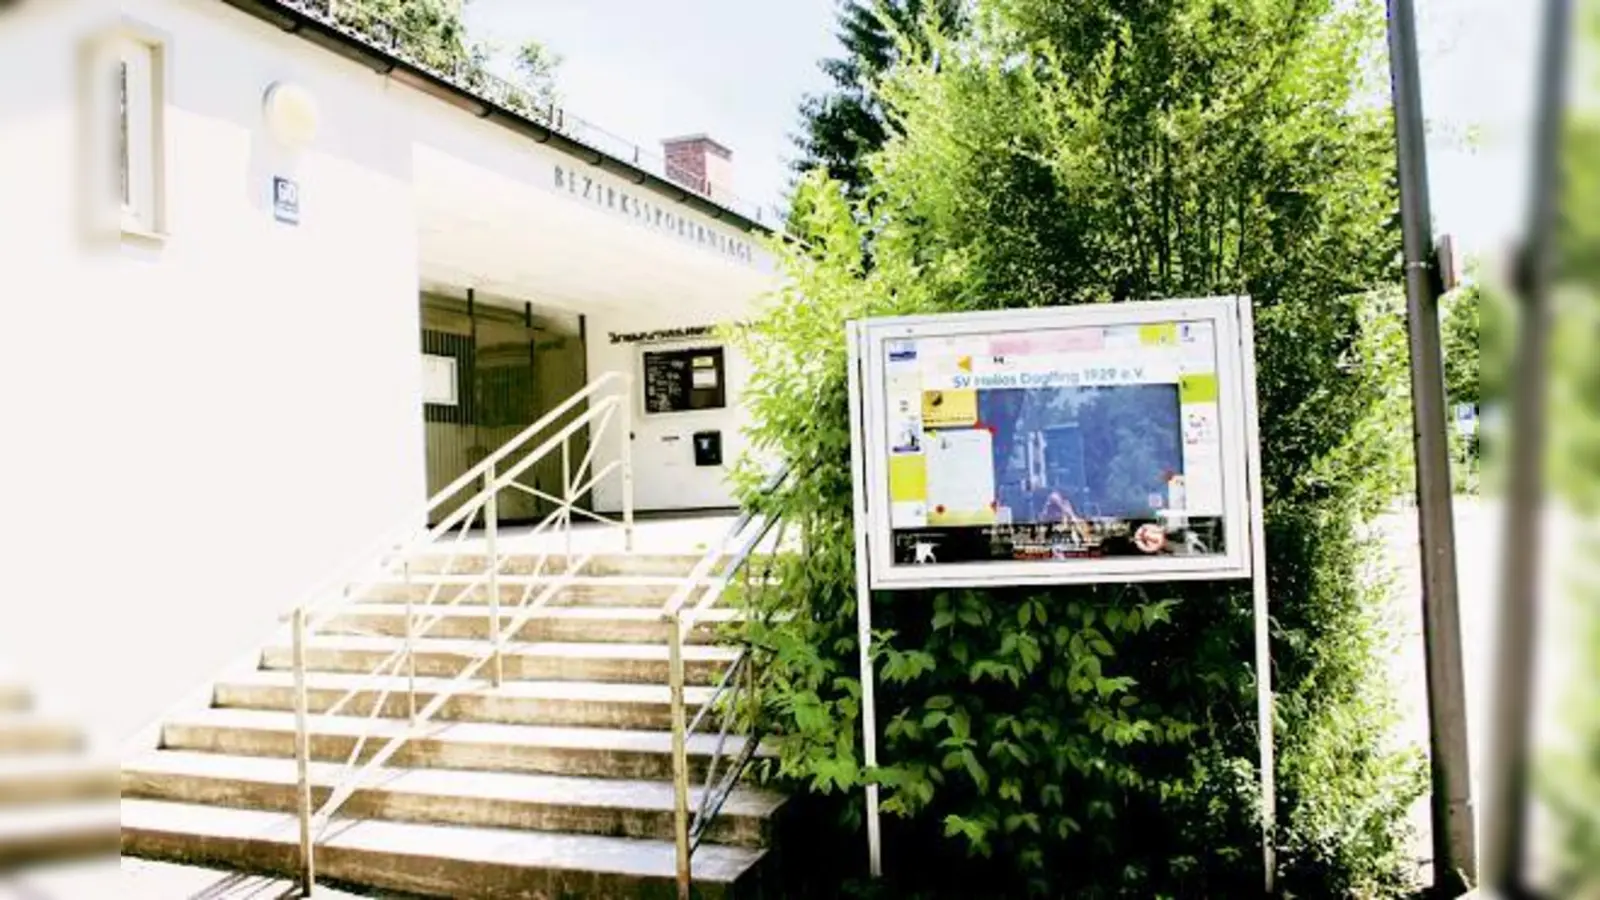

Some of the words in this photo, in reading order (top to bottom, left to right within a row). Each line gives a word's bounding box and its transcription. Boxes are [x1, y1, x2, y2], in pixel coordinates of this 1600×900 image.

[554, 164, 753, 263] BEZIRKSSPORTANLAGE
[953, 374, 970, 388] SV
[974, 372, 1017, 386] Helios
[1084, 367, 1116, 381] 1929
